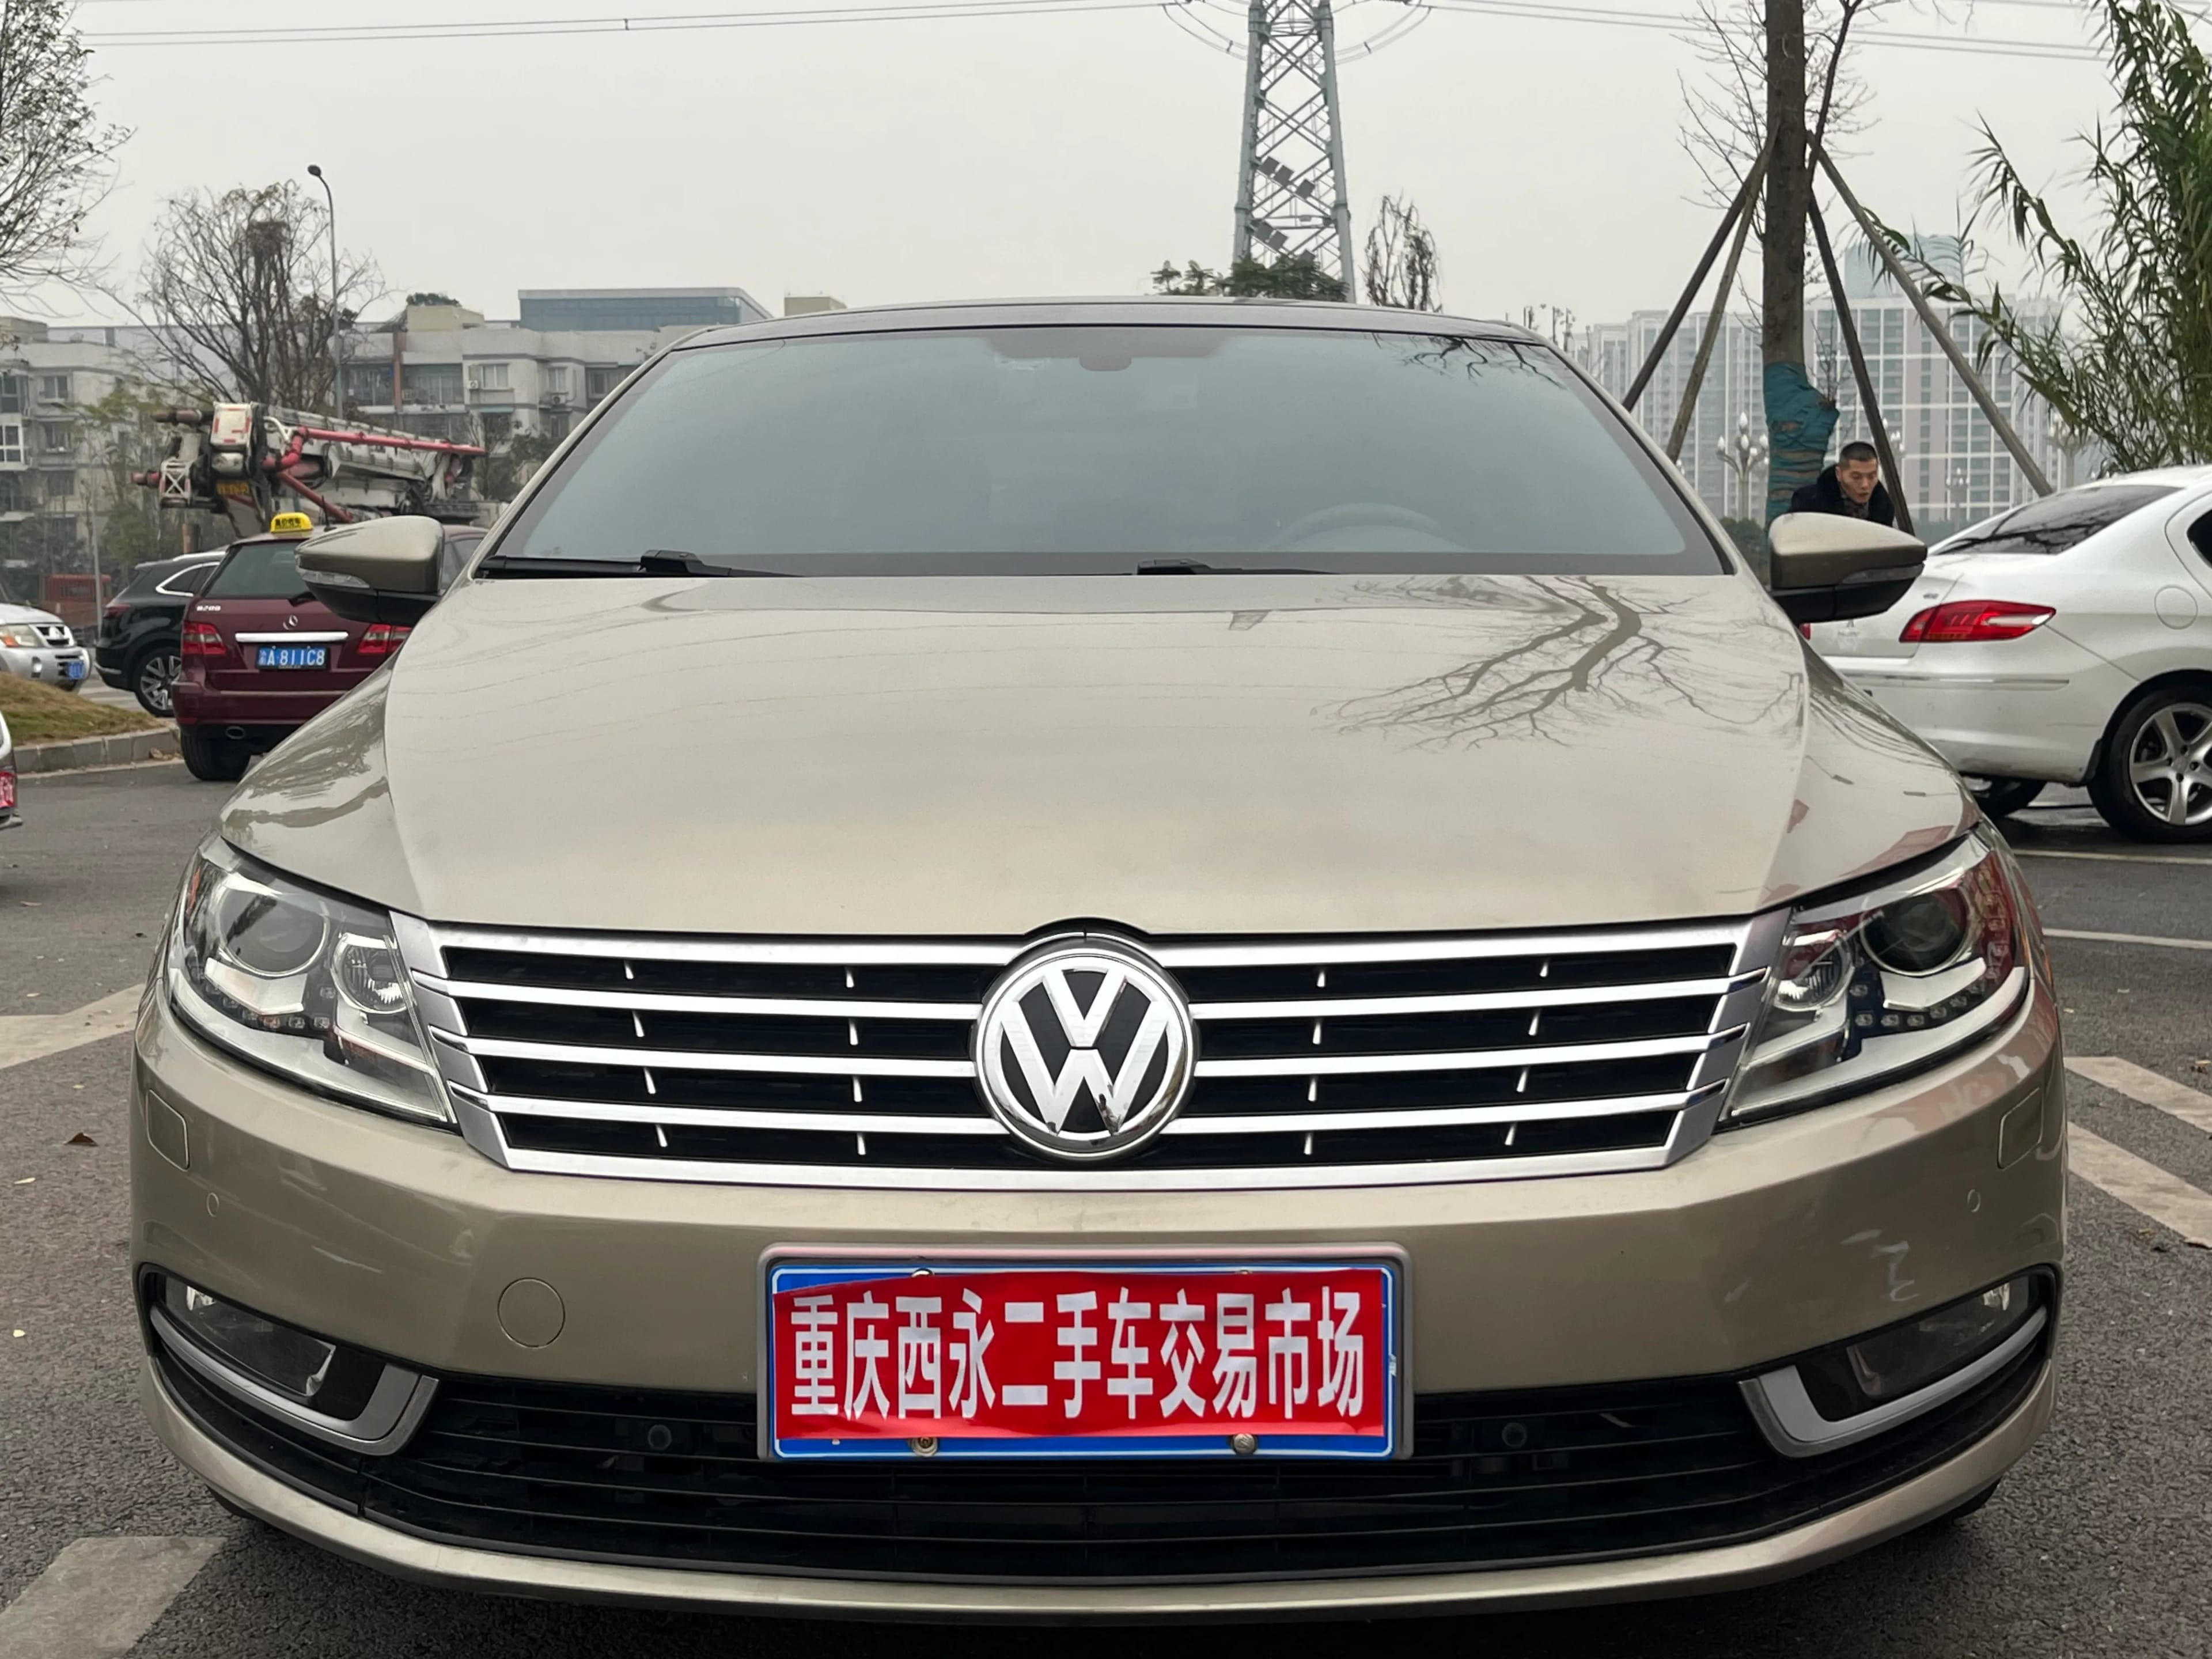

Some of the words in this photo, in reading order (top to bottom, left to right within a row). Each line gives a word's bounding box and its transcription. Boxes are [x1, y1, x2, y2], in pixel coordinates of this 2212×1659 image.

[791, 1286, 1363, 1421] 重庆西永二手车交易市场
